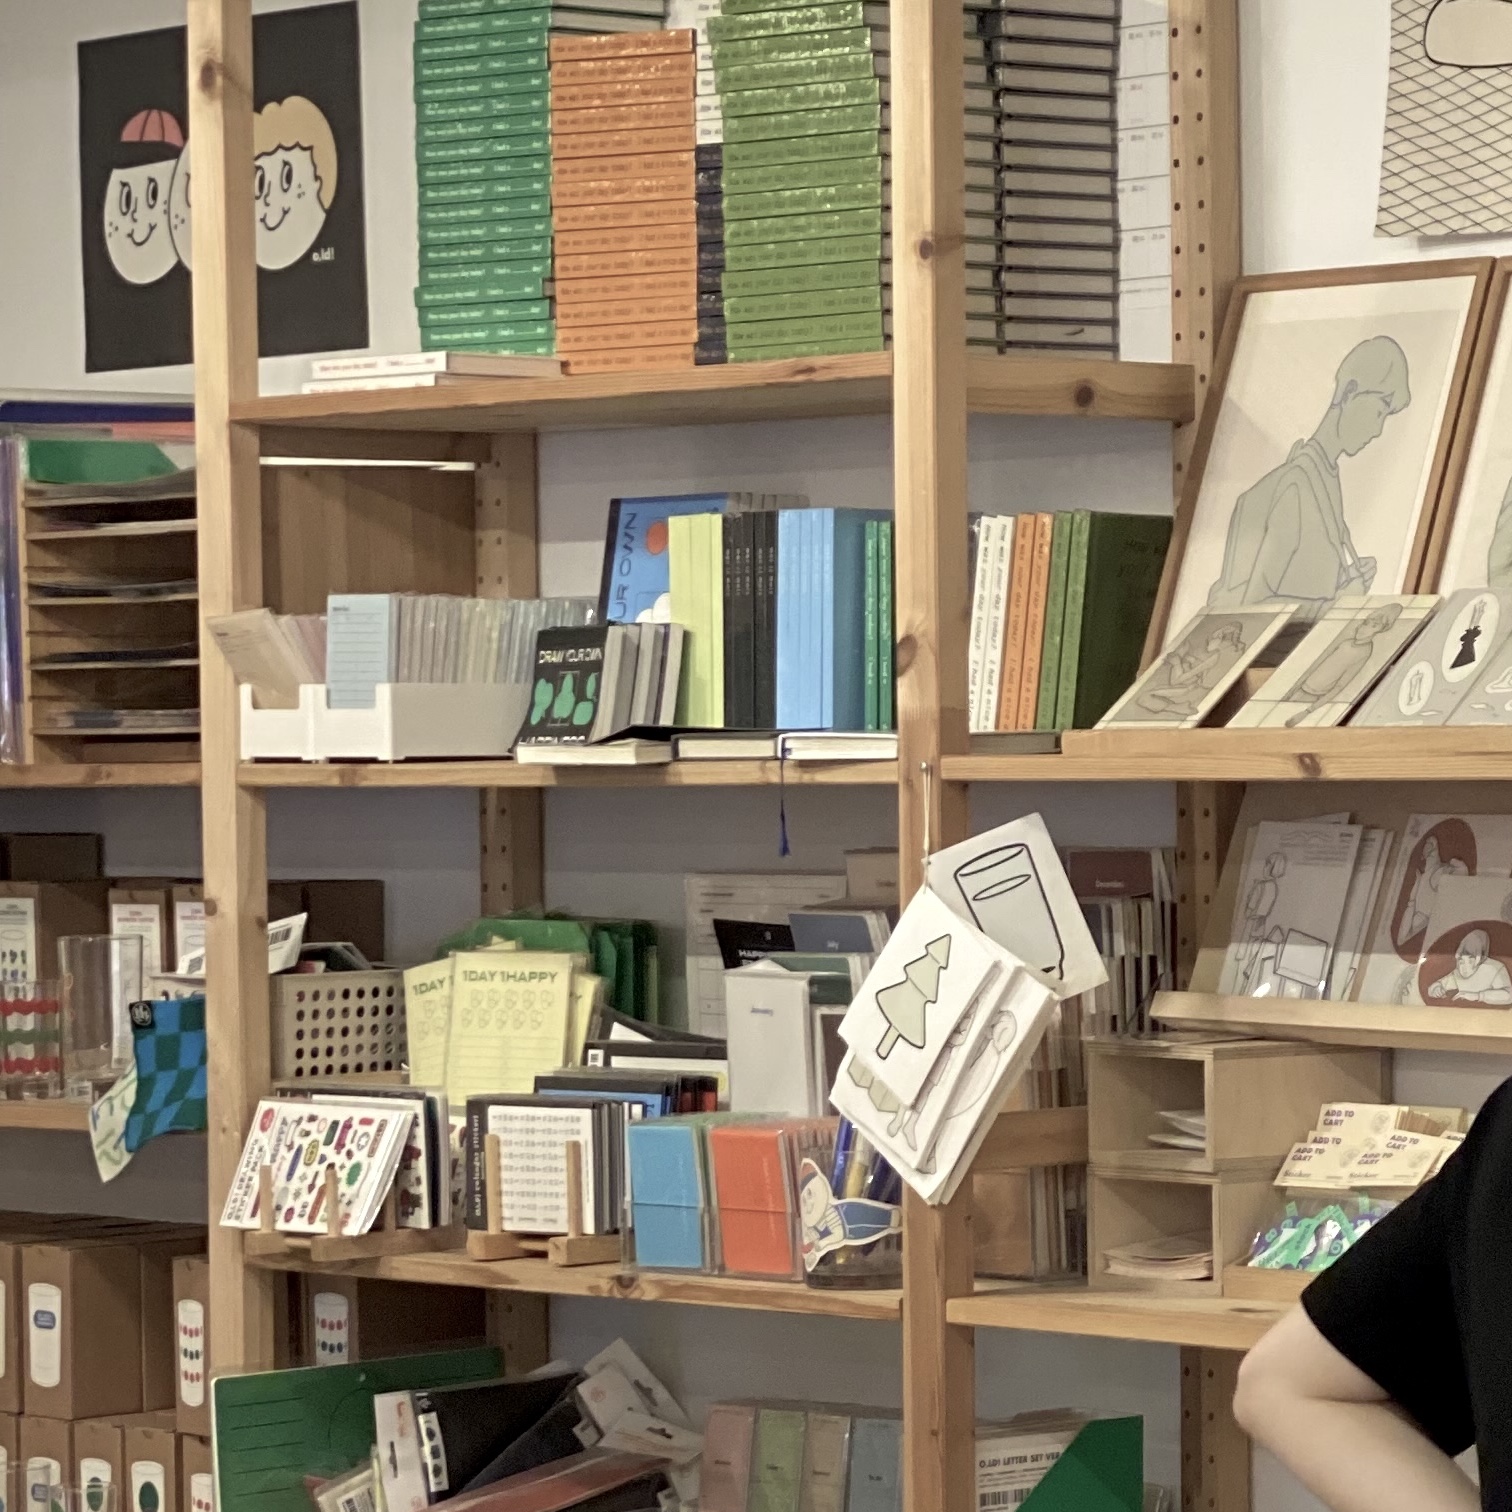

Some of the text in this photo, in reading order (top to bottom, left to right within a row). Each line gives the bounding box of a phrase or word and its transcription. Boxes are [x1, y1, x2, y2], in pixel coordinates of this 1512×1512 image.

[463, 970, 558, 985] 1DAY 1HAPPY
[412, 977, 446, 995] 1DAY
[1324, 1109, 1355, 1118] ADD TO
[1323, 1118, 1344, 1127] CART
[1313, 1136, 1342, 1145] ADD TO
[1390, 1134, 1420, 1145] ADD TO
[1386, 1141, 1407, 1150] CART
[1294, 1147, 1314, 1155] ADD
[1291, 1153, 1313, 1162] CART
[1003, 1455, 1028, 1465] LETTER
[1030, 1453, 1044, 1463] SET
